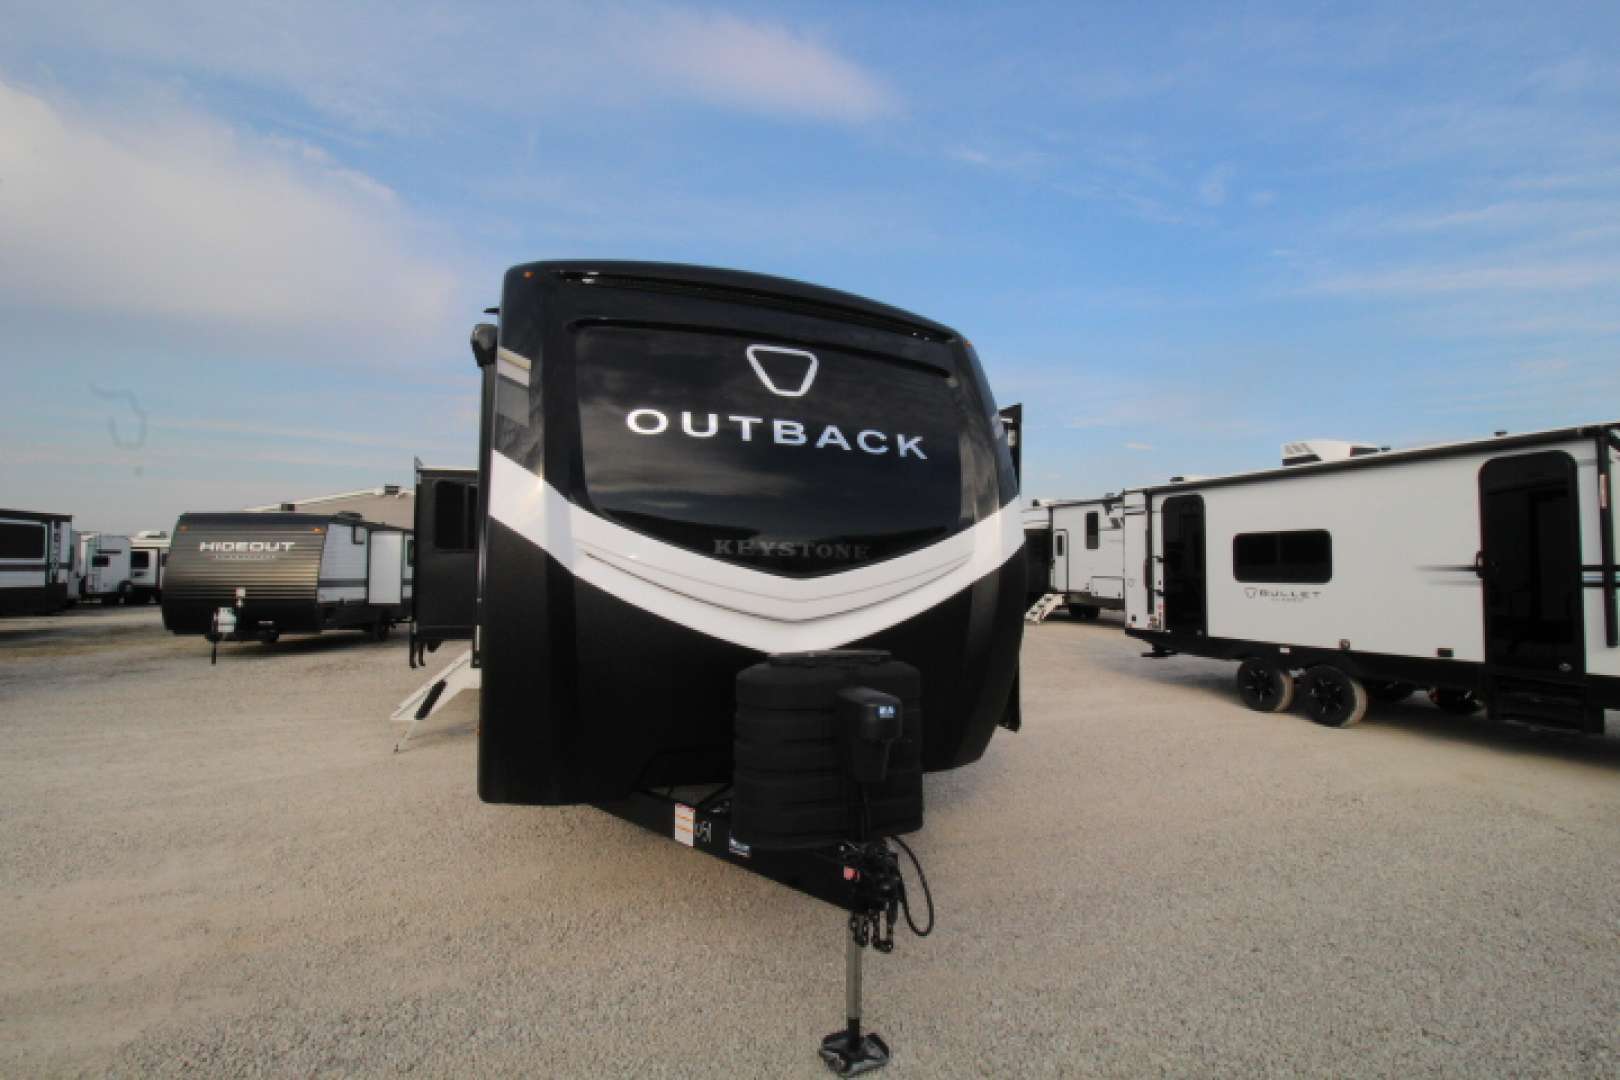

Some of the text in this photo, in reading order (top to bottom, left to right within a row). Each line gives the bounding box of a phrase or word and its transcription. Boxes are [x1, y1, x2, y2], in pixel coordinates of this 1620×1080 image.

[626, 408, 928, 460] OUTBACK
[199, 541, 296, 552] HIDEOUT
[713, 538, 871, 560] KEYSTONE
[1259, 588, 1322, 599] BULLET
